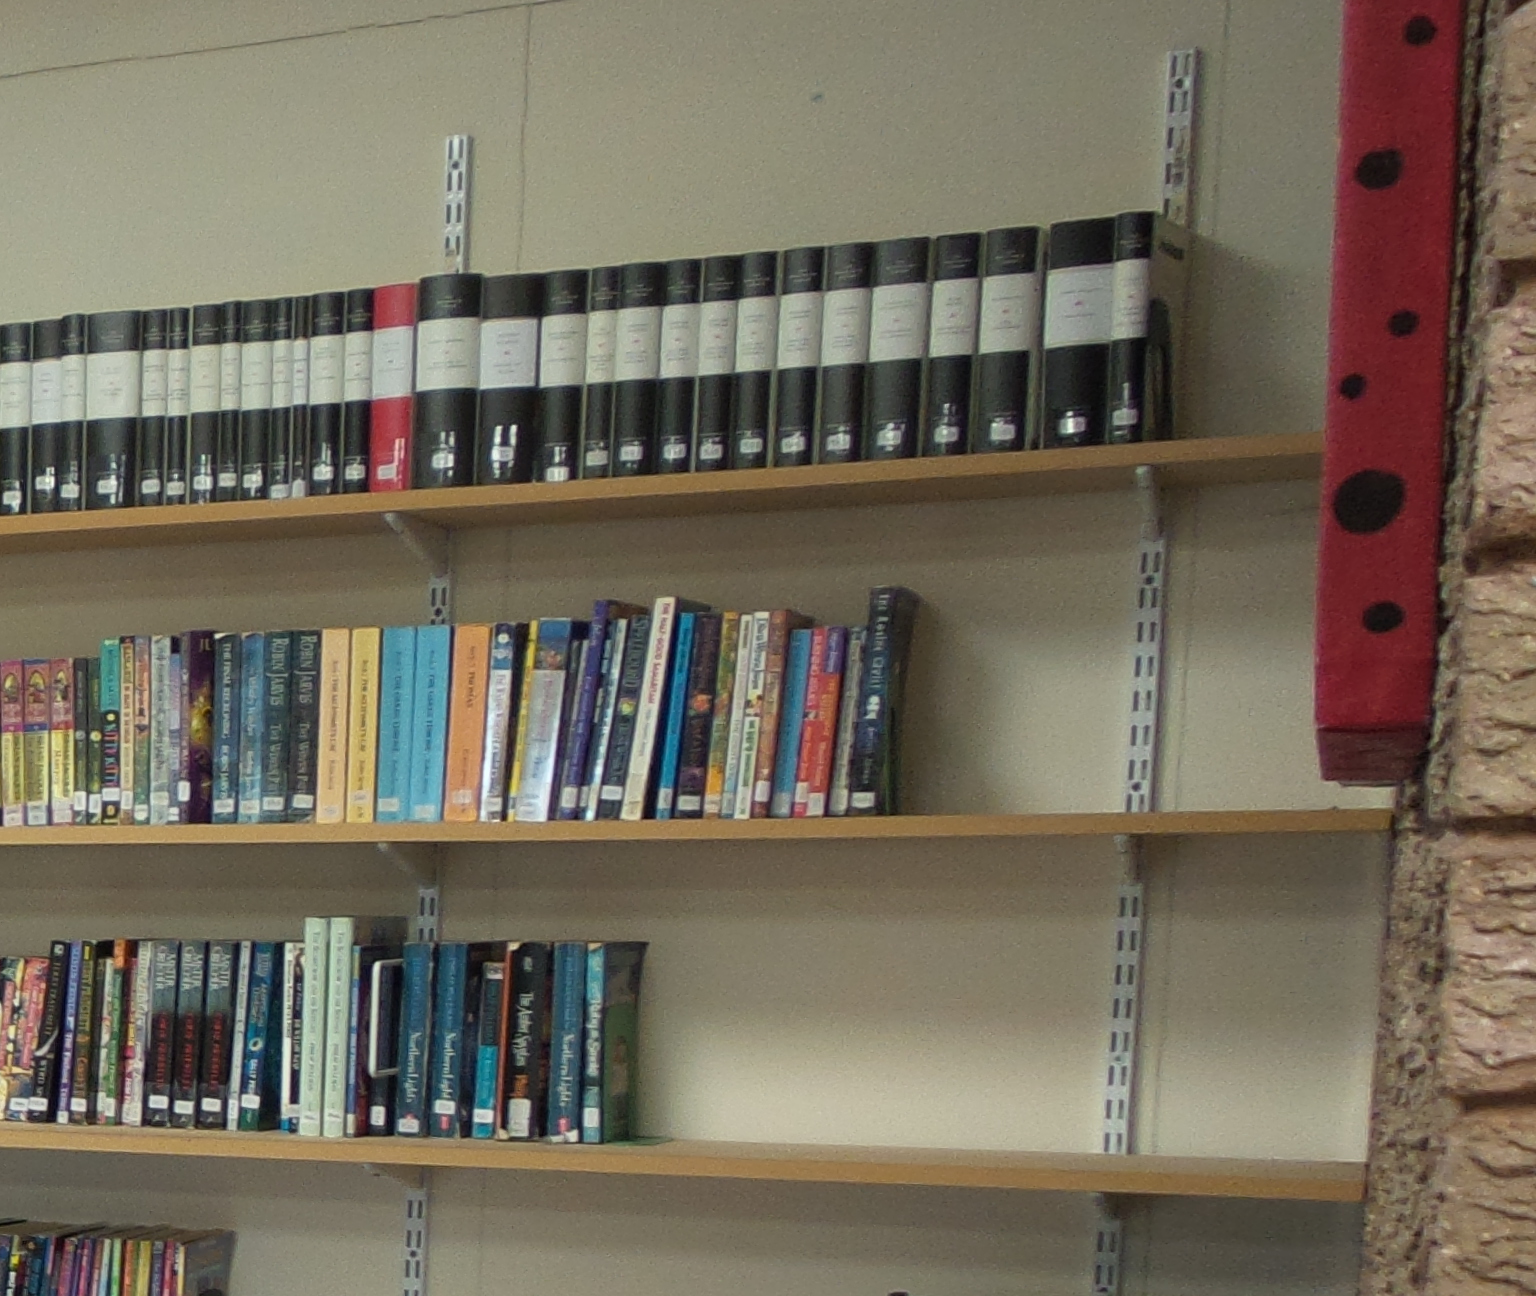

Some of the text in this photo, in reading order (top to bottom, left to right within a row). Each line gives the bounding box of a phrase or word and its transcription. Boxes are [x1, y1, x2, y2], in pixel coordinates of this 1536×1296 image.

[270, 637, 290, 670] ROBIN
[300, 635, 317, 668] ROBIN
[266, 671, 288, 707] JARVIS
[294, 670, 317, 705] JARVIS
[440, 1032, 458, 1099] Northern Light
[558, 1034, 575, 1107] Northern Lights
